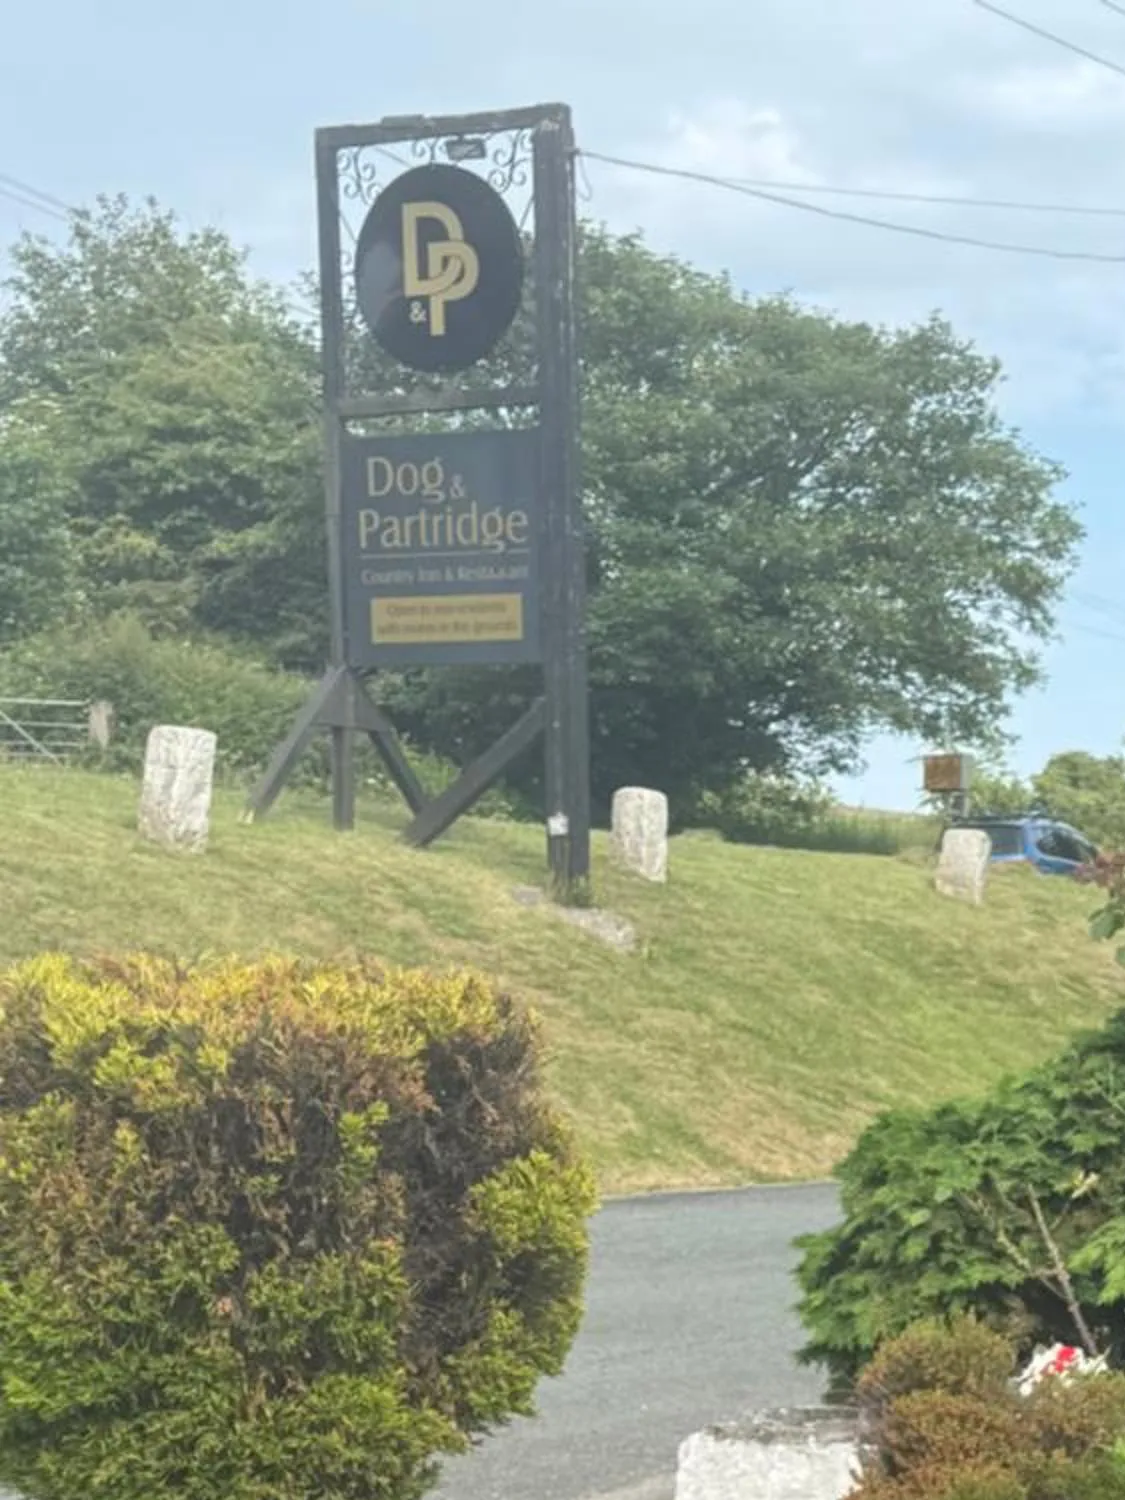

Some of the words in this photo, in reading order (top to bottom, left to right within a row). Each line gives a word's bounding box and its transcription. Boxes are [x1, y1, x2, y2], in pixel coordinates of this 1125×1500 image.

[367, 456, 445, 503] Dog
[450, 474, 466, 499] &
[358, 500, 529, 552] Partridge
